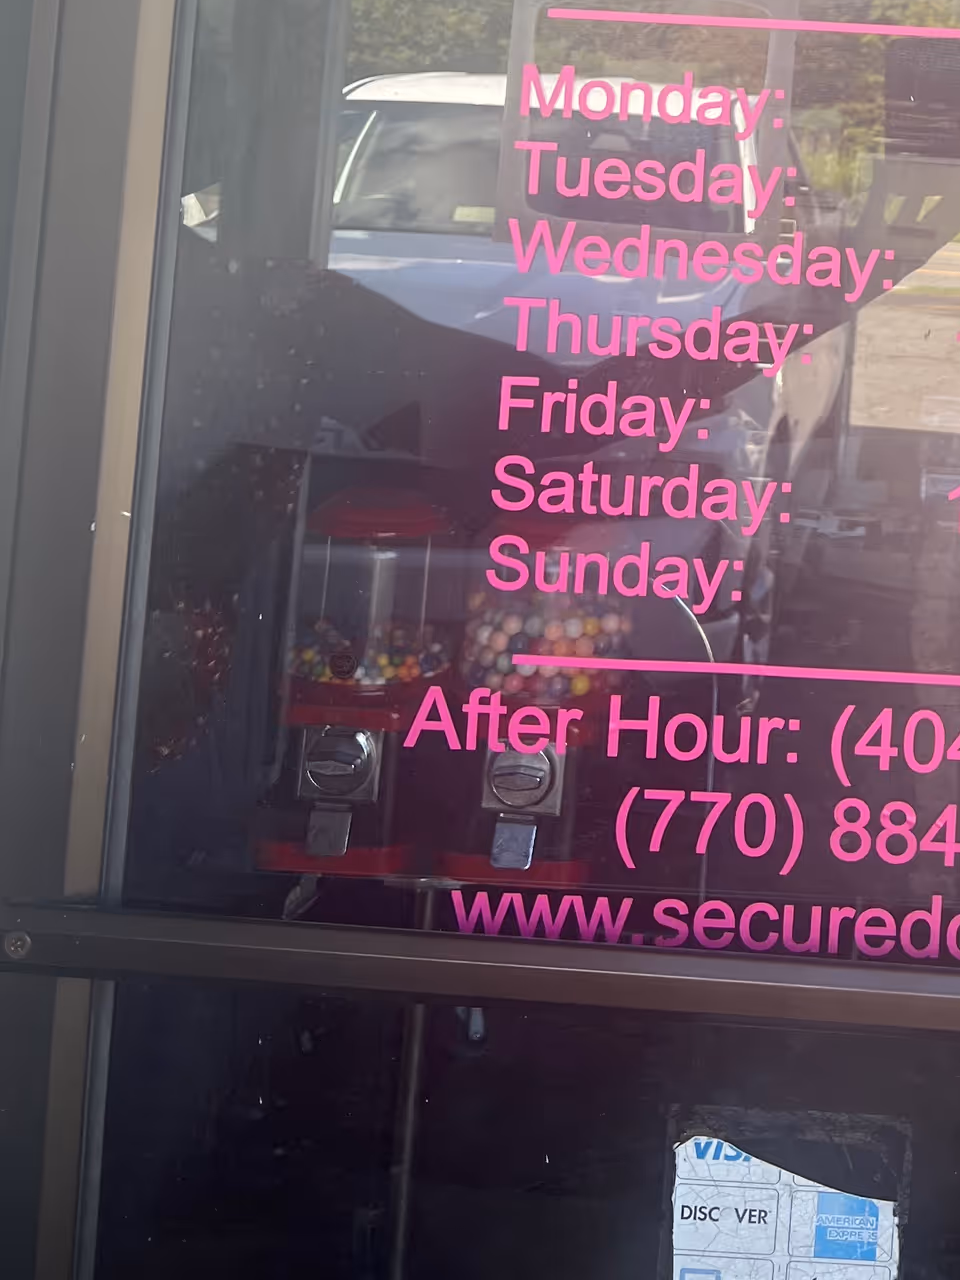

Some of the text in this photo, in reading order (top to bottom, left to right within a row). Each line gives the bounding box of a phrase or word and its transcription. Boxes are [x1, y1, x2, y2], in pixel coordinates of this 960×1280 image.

[519, 63, 785, 141] Monday:
[513, 140, 798, 219] Tuesday:
[507, 217, 895, 303] Wednesday:
[502, 296, 814, 379] Thursday:
[498, 375, 712, 453] Friday:
[490, 454, 793, 537] Saturday:
[484, 533, 745, 615] Sunday:
[402, 685, 585, 754] After
[606, 693, 801, 766] Hour:
[615, 786, 805, 876] (770)
[693, 1140, 752, 1162] VIS
[680, 1204, 769, 1225] DISCVER
[816, 1214, 876, 1228] AMERICAN
